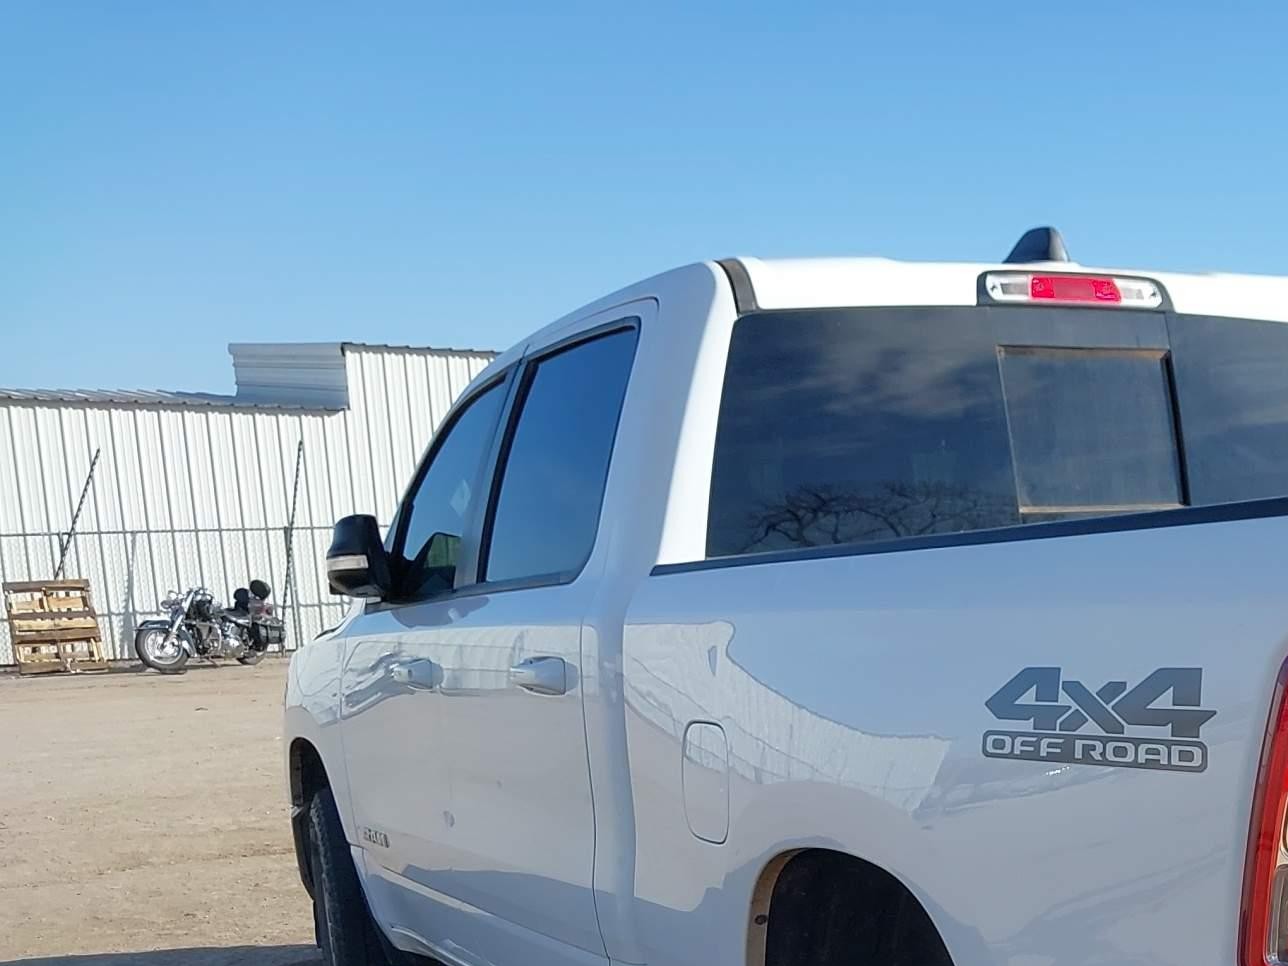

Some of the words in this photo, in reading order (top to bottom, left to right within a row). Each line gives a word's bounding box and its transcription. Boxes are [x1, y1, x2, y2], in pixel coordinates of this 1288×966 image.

[985, 667, 1217, 738] 4x4
[985, 734, 1065, 758] OFF
[1074, 739, 1203, 767] ROAD
